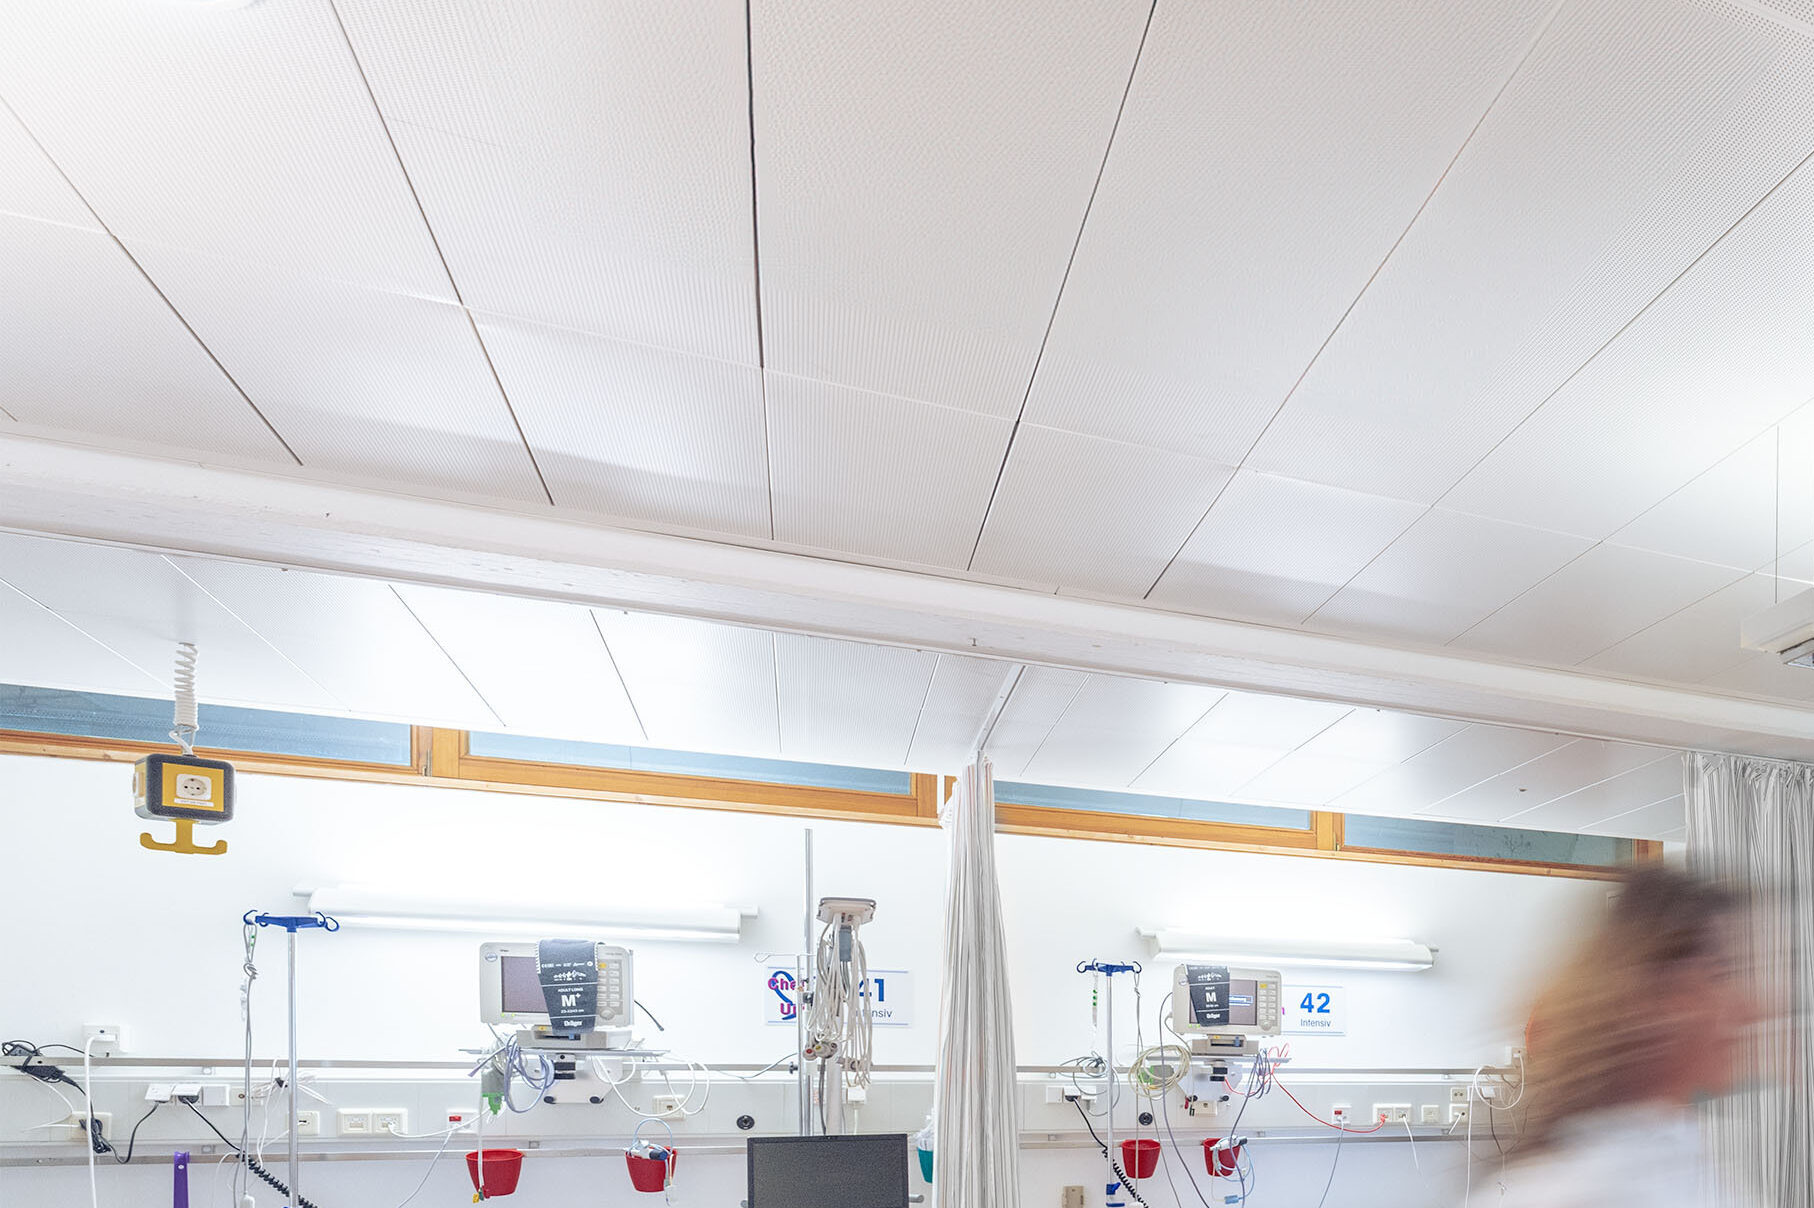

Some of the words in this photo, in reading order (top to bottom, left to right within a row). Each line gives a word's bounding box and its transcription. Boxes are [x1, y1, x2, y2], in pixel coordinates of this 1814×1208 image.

[1205, 991, 1217, 1003] M
[1300, 992, 1331, 1014] 42
[1300, 1018, 1332, 1028] Intensiv
